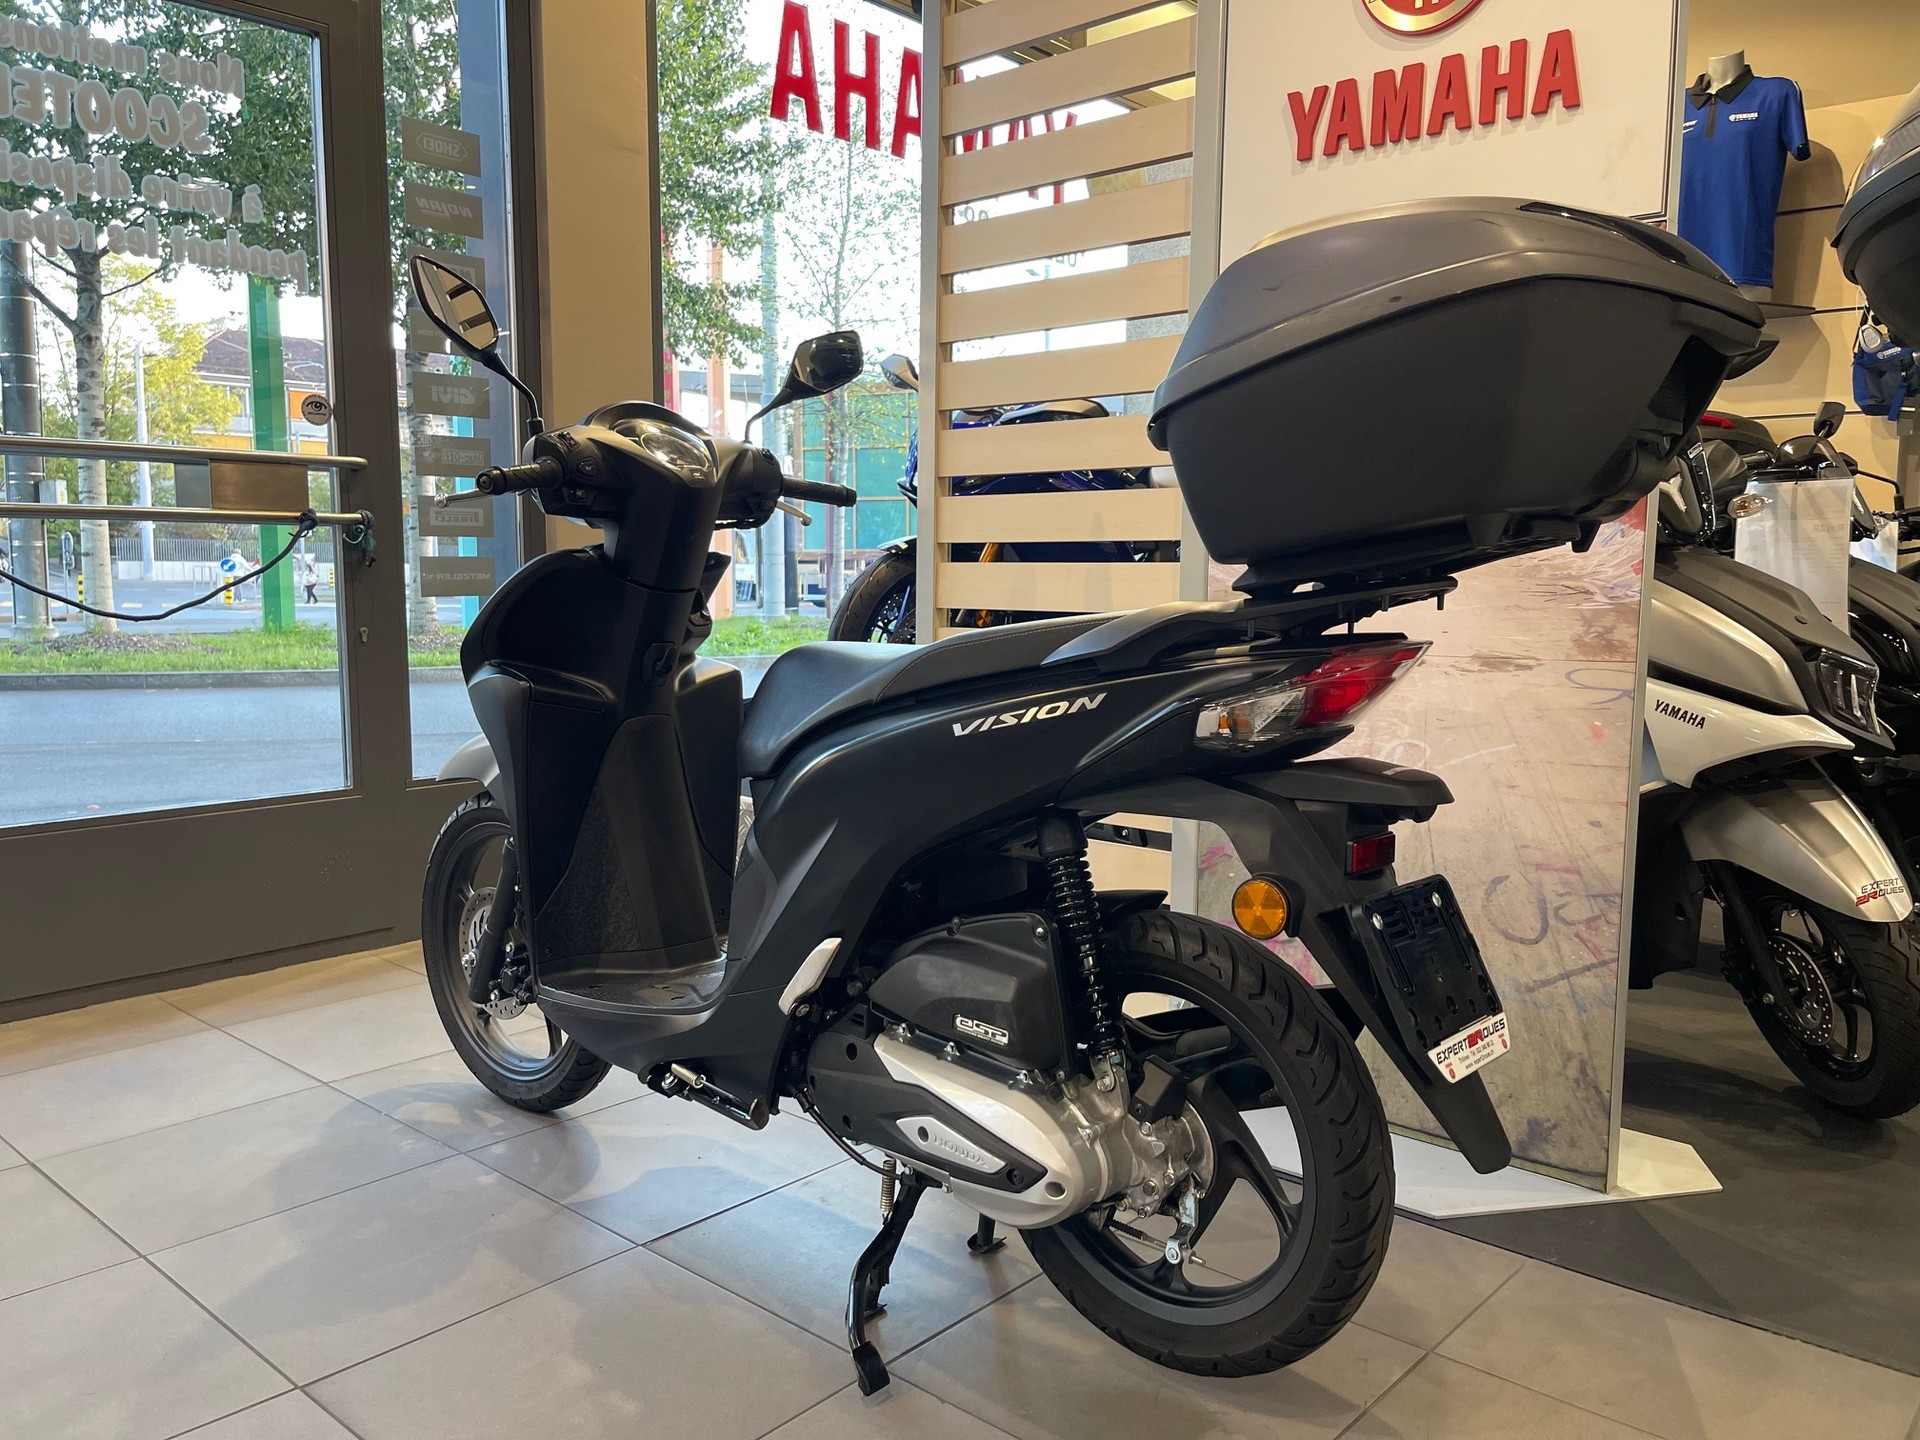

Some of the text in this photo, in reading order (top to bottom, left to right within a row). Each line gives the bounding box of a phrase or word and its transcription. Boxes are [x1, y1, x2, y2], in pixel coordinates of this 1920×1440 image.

[1287, 29, 1580, 161] YAMAHA
[952, 693, 1107, 737] VISION
[1655, 699, 1706, 729] YAMAHA
[1861, 877, 1899, 894] EXPERT
